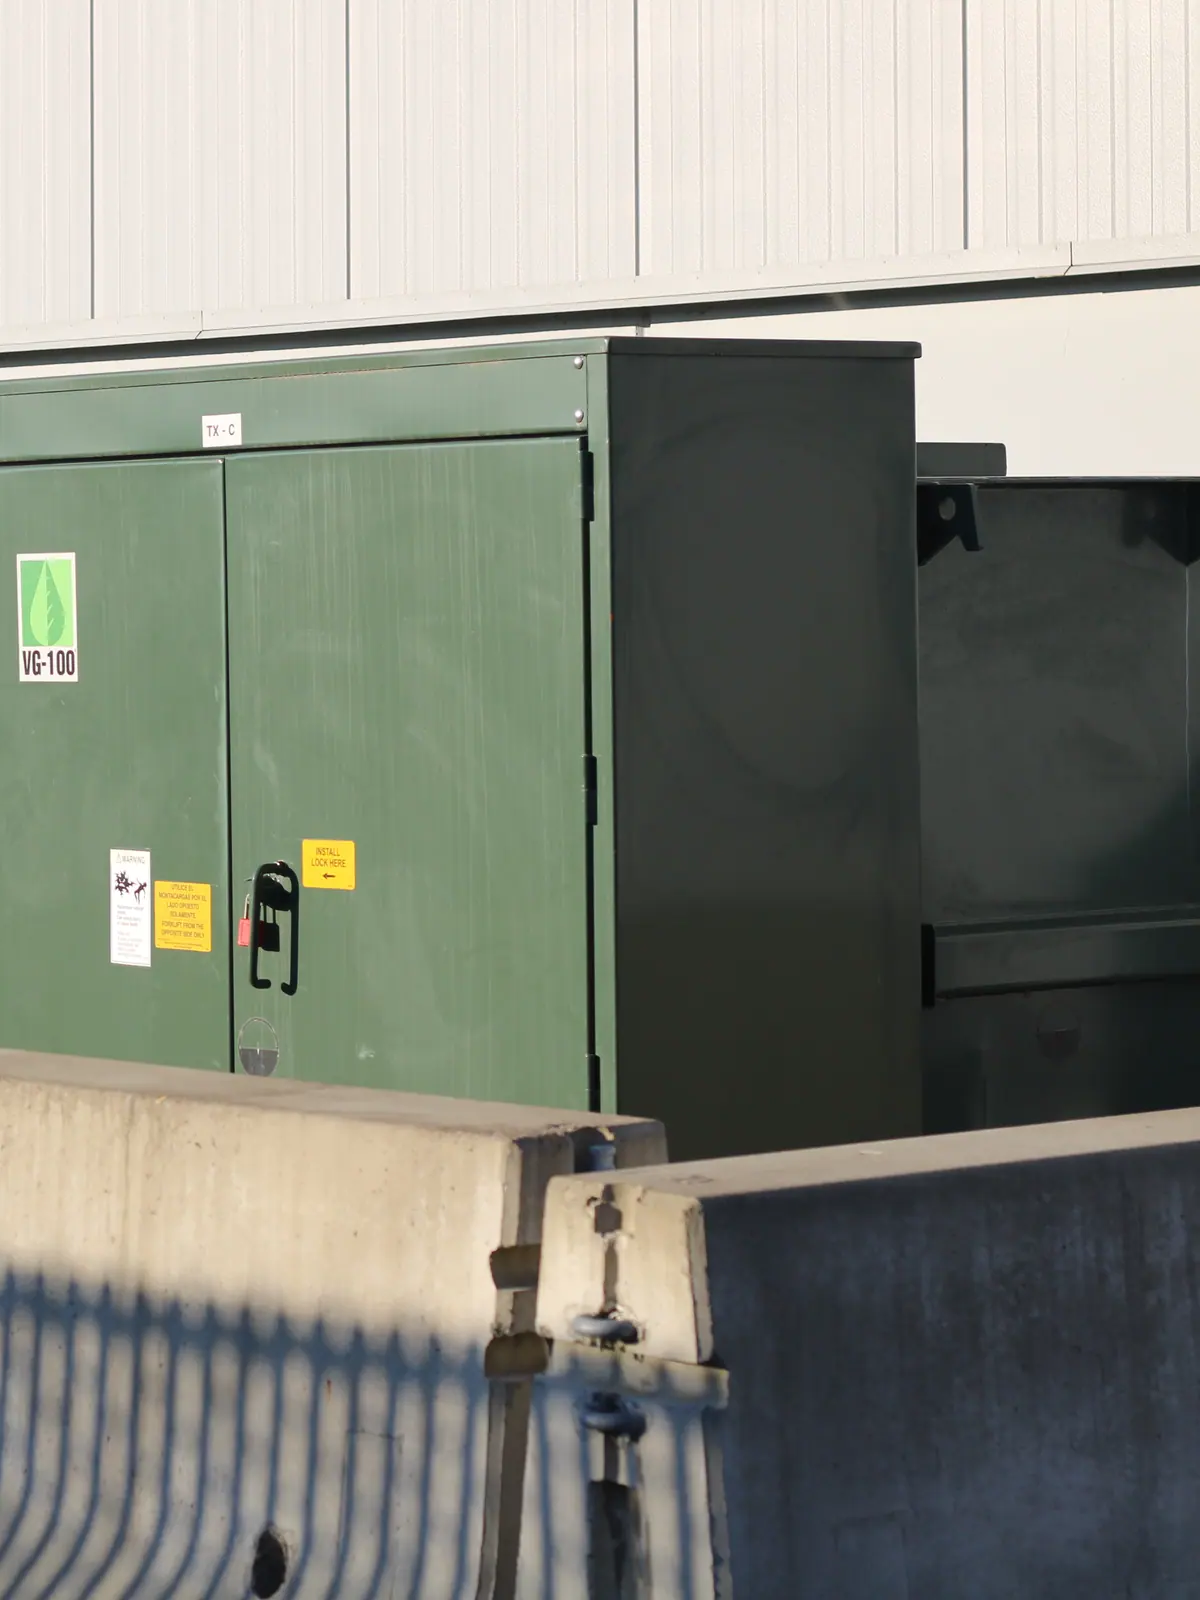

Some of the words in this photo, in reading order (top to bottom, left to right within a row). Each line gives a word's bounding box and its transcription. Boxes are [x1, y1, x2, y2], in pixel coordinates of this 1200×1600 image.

[22, 650, 76, 676] VG-100
[315, 847, 340, 857] INSTALL
[311, 858, 328, 868] LOCK
[329, 858, 347, 868] HERE
